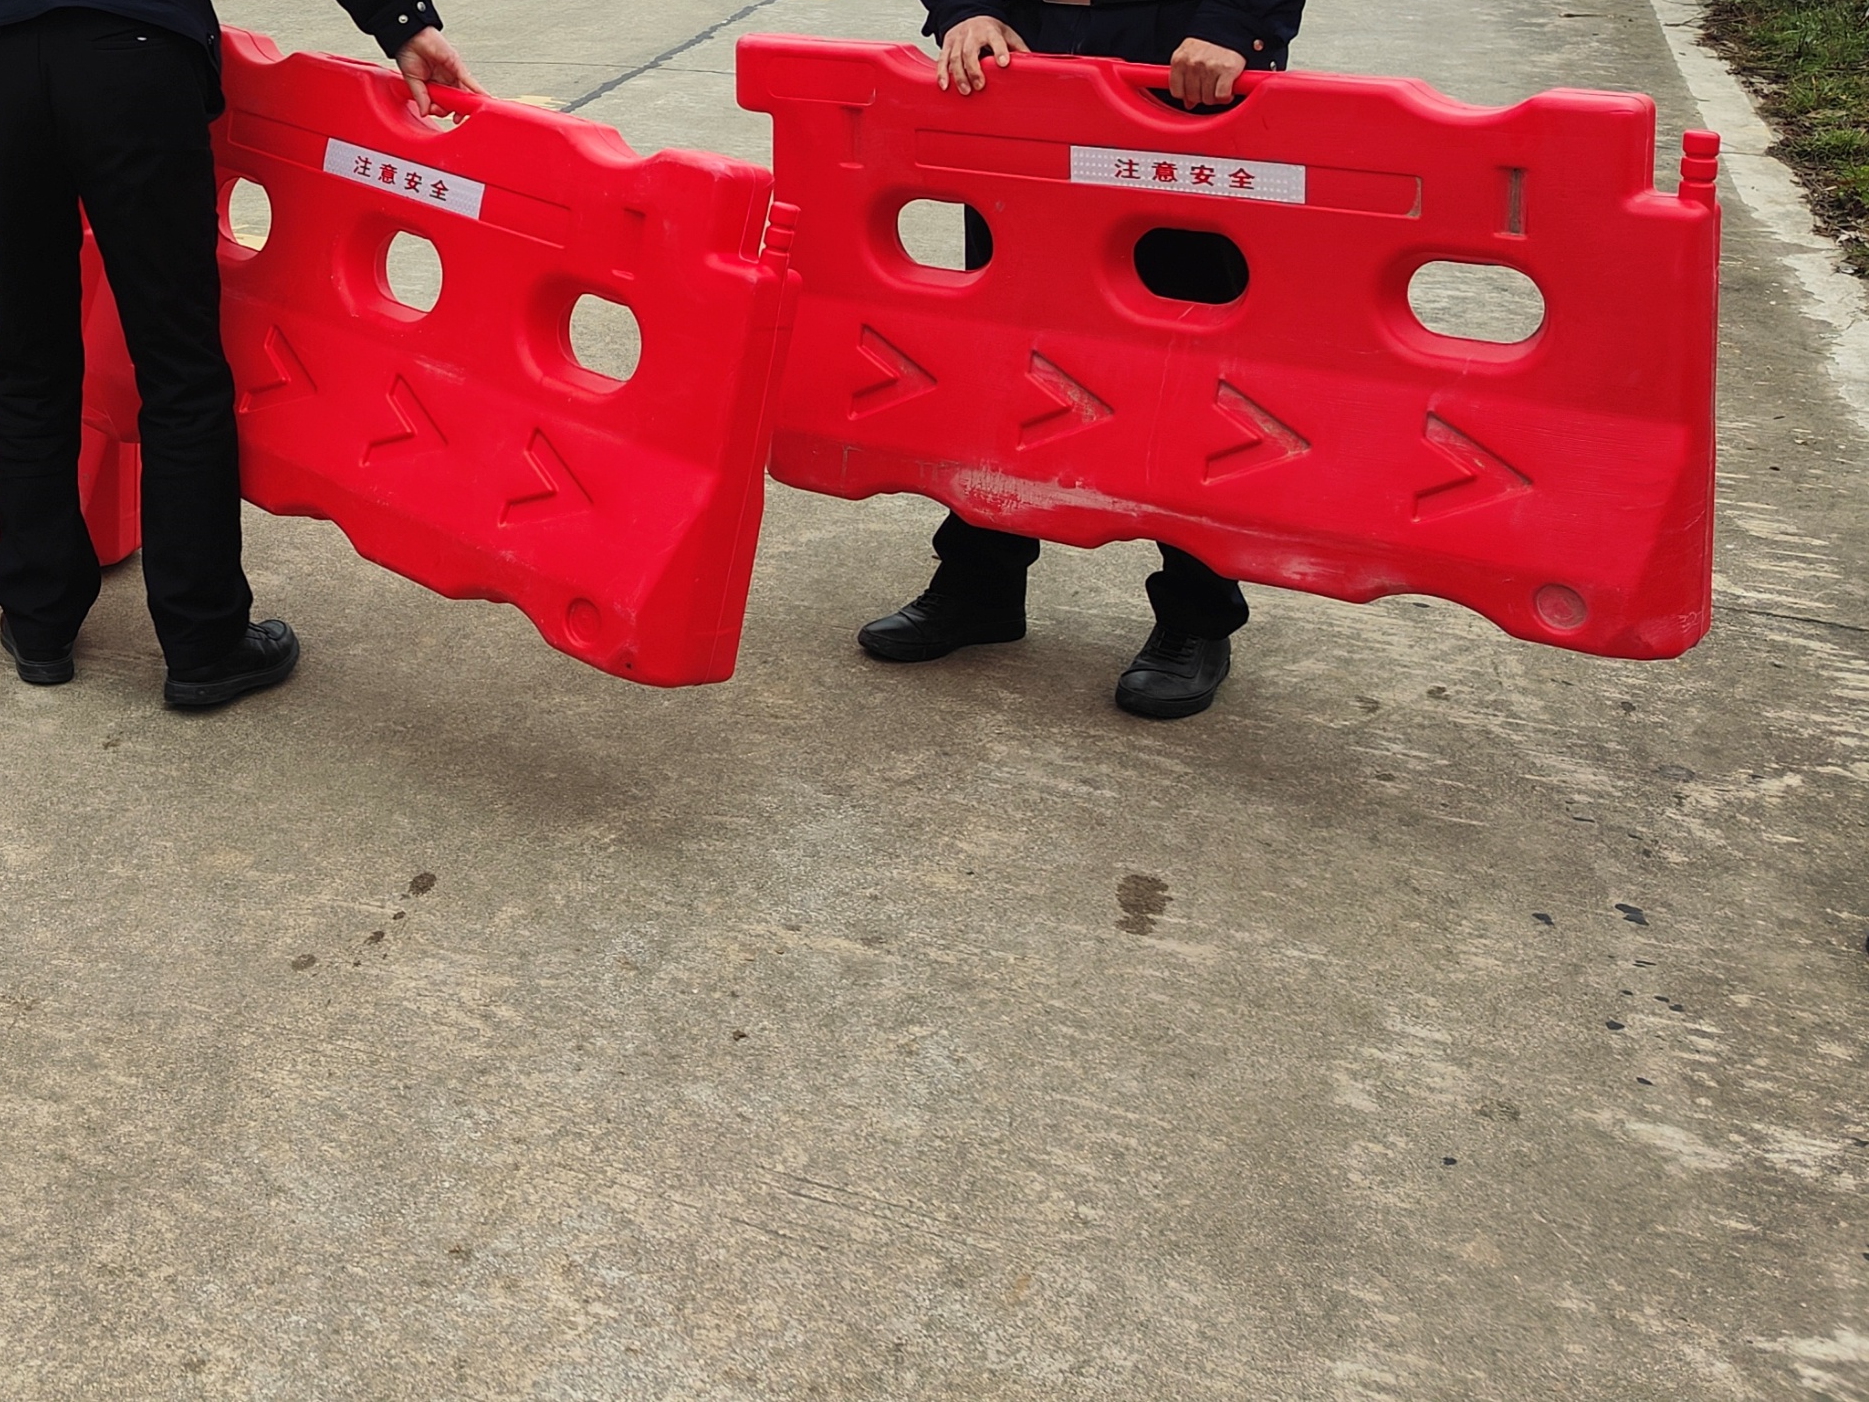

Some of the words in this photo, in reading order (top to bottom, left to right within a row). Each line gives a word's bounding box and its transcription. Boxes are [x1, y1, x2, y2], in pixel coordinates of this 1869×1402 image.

[352, 155, 450, 202] 注意安全
[1113, 158, 1256, 191] 注意安全
